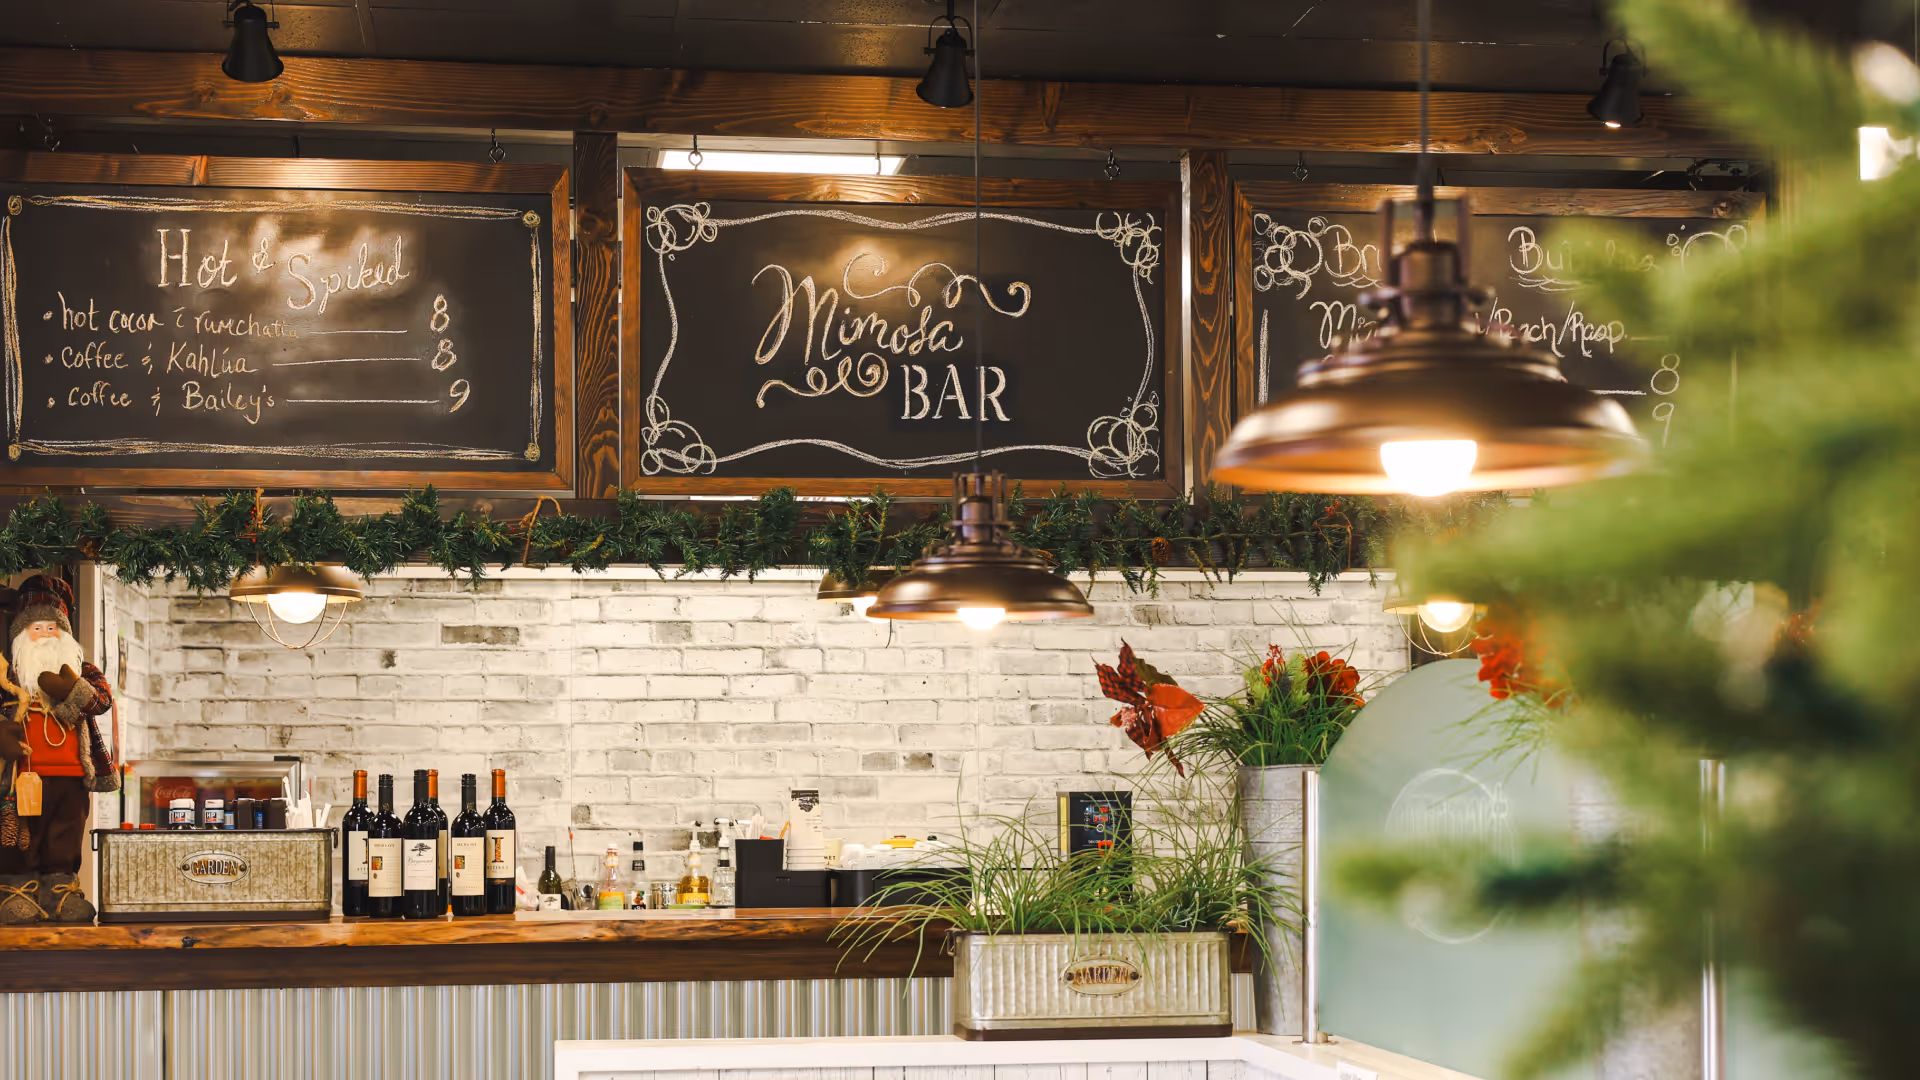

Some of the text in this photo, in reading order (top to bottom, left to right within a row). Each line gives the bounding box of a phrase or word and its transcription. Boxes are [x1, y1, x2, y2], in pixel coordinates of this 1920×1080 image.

[157, 228, 411, 314] Hot & Spiked
[58, 291, 100, 332] hot
[109, 310, 164, 334] cocoa
[429, 294, 450, 333] 8
[751, 263, 964, 365] Mimosa
[431, 338, 457, 371] 8
[1650, 353, 1680, 395] 8
[182, 381, 275, 424] Bailey's
[448, 379, 471, 413] 9
[901, 363, 1012, 421] BAR
[1652, 402, 1675, 447] 9
[190, 859, 239, 876] GARDEN
